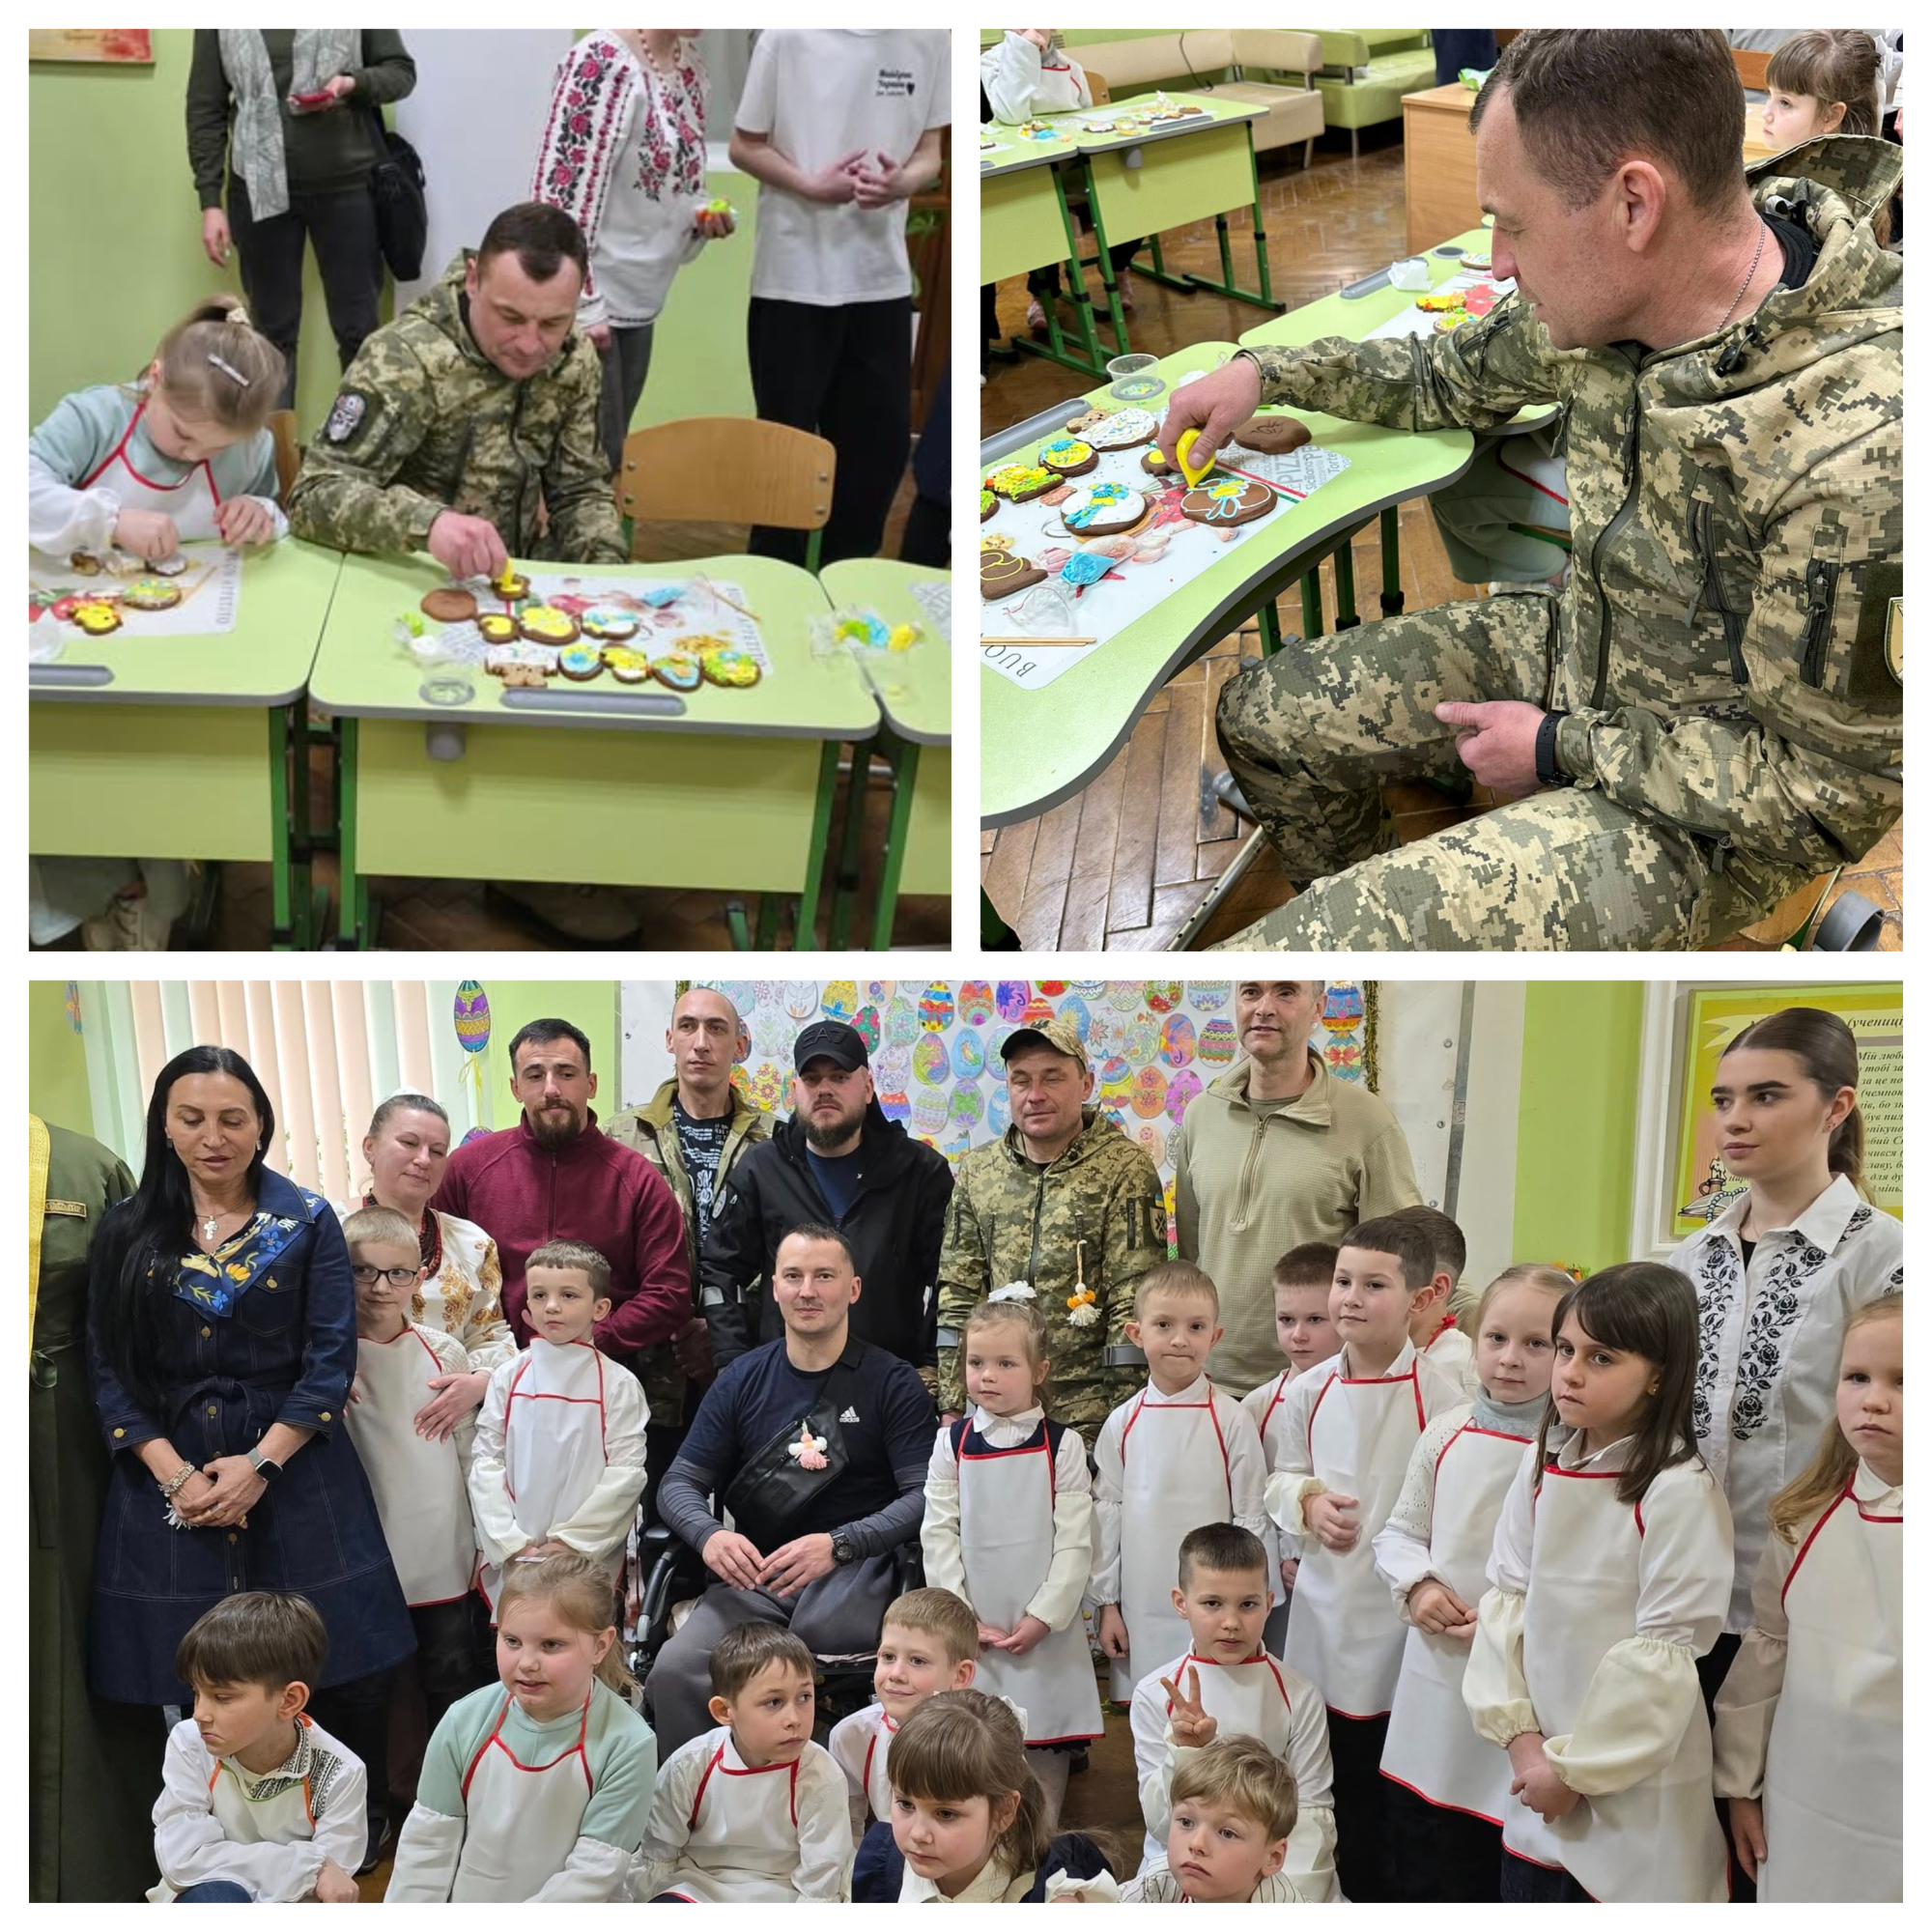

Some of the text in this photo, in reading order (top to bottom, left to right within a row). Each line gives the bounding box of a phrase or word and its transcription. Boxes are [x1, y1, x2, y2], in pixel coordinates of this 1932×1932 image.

[1301, 445, 1322, 460] PE
[1275, 450, 1302, 484] PIZZ
[1864, 1064, 1890, 1073] тобі
